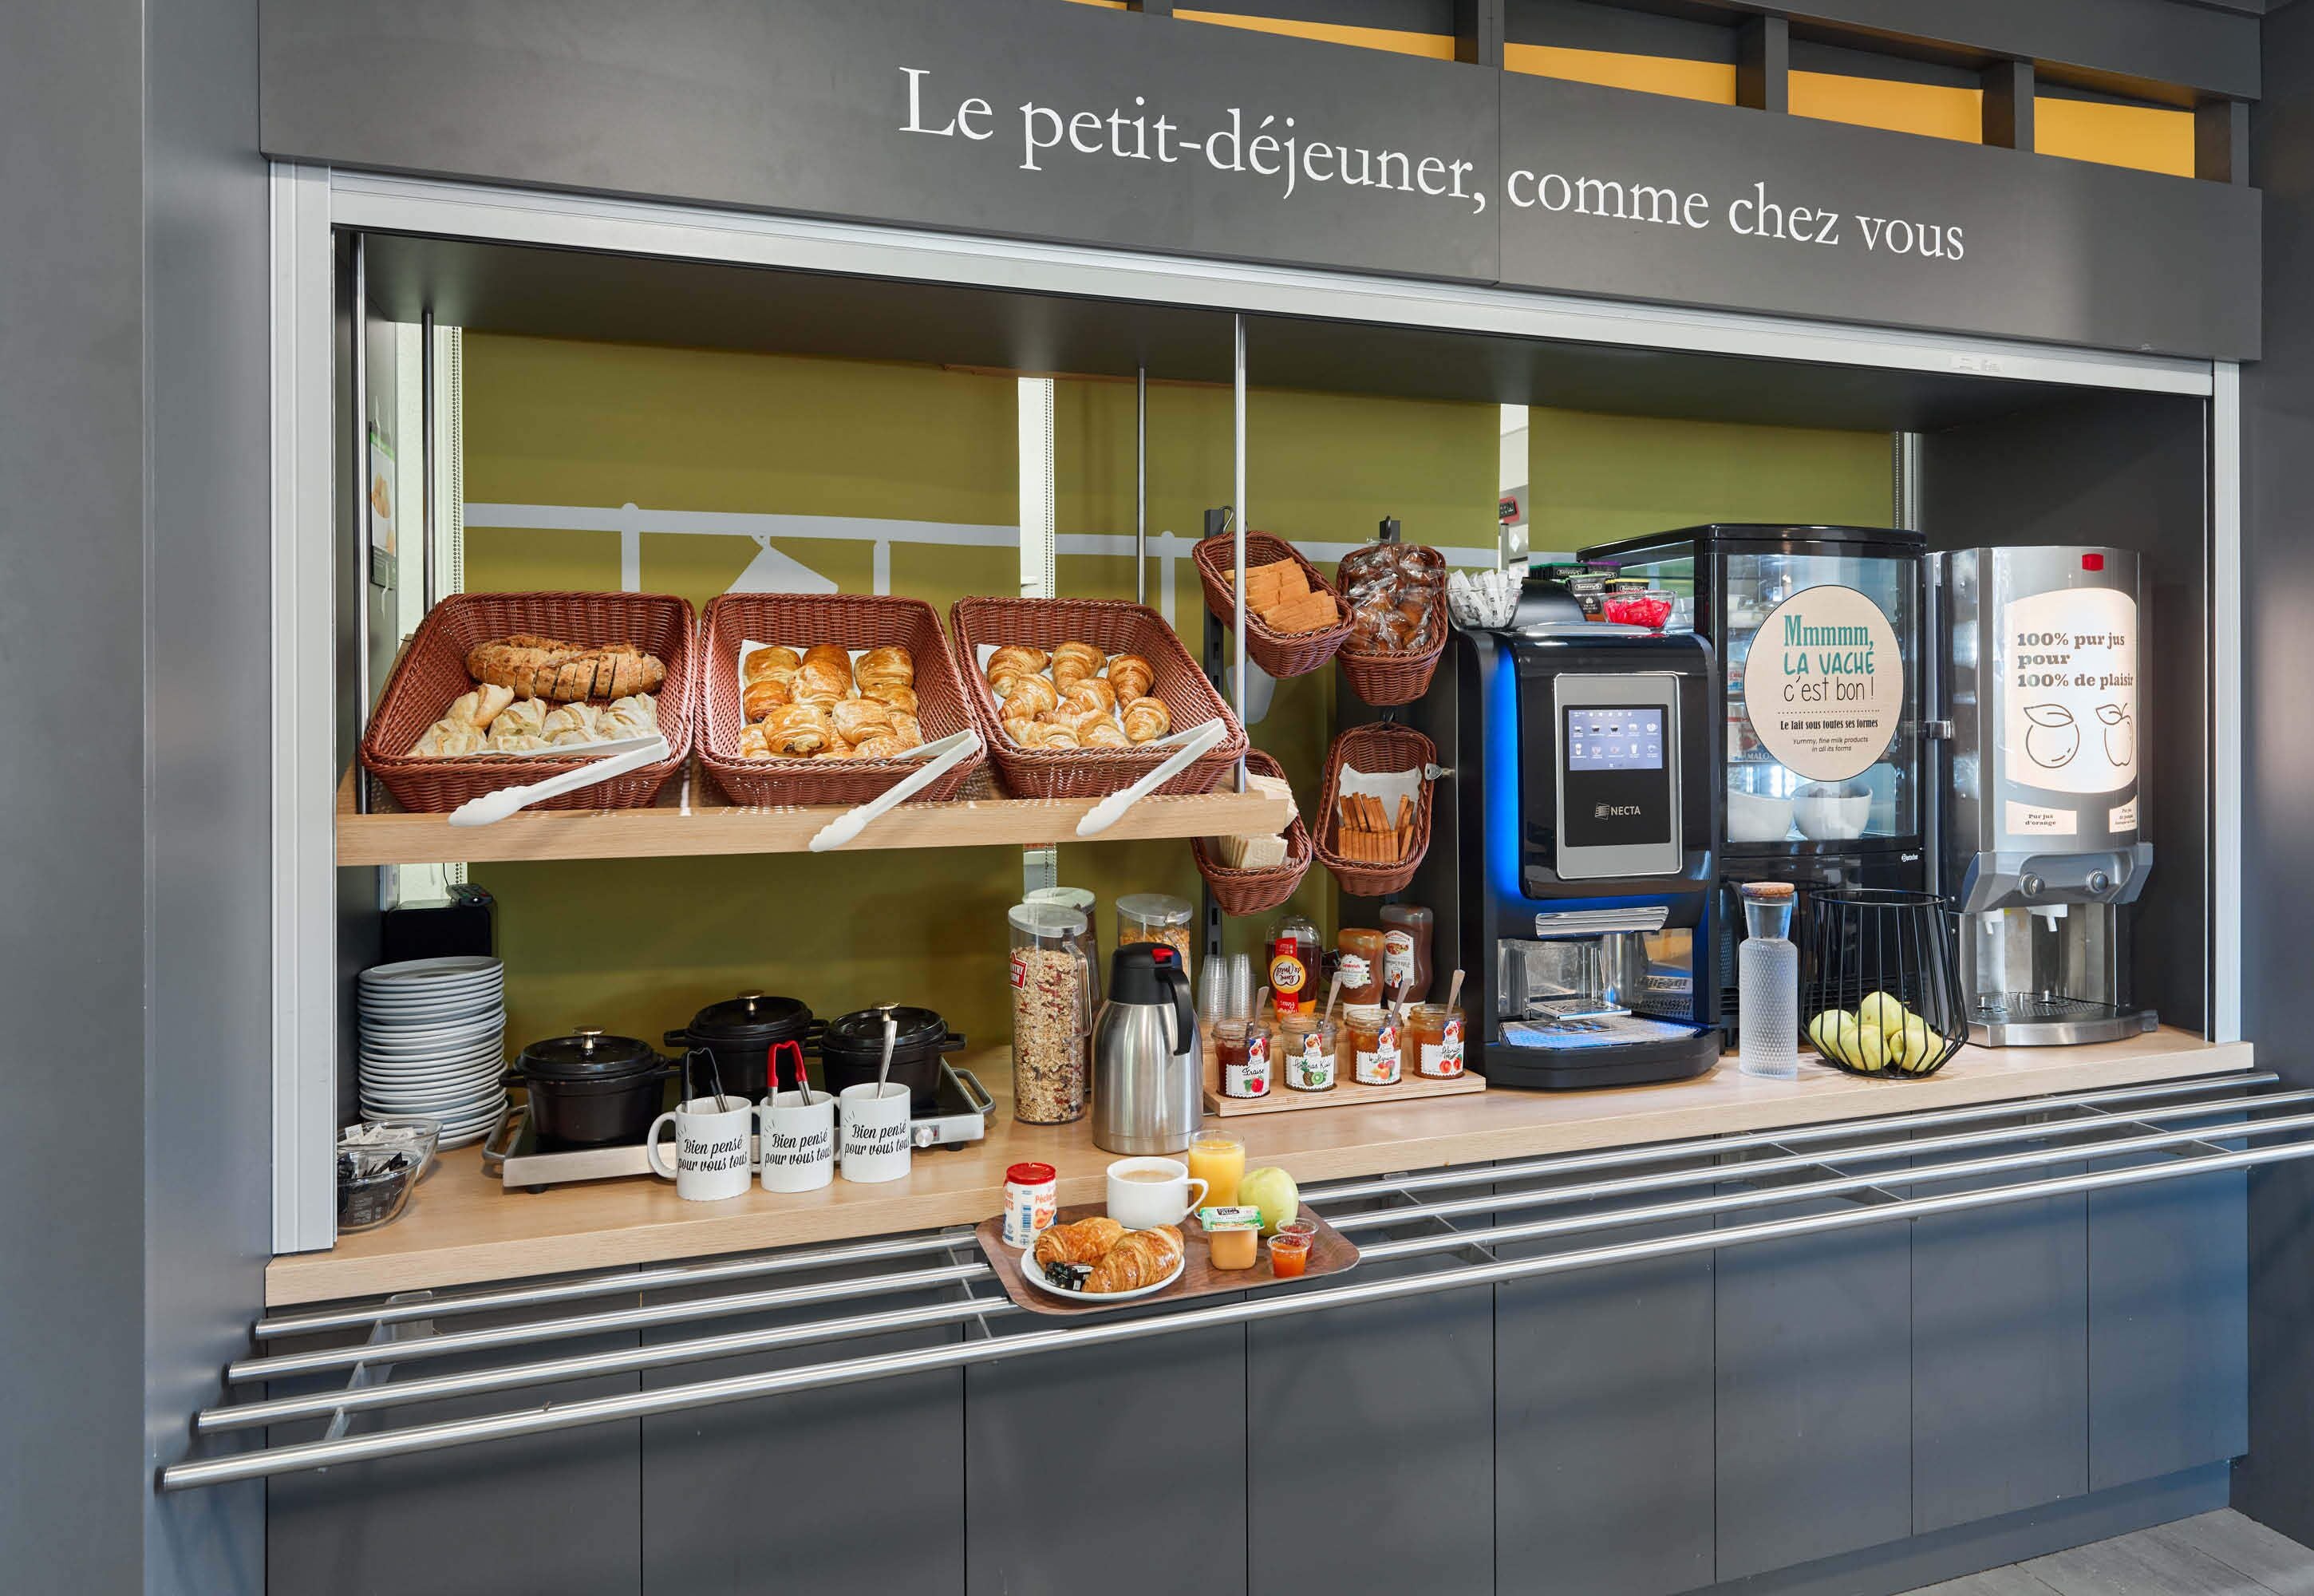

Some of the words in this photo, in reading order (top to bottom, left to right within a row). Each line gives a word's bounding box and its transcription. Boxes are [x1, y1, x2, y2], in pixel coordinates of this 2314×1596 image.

[898, 66, 994, 140] Le
[1019, 96, 1487, 215] petit-déjeuner,
[1507, 169, 1709, 229] comme
[1728, 182, 1839, 245] chez
[1855, 215, 1965, 260] vous
[1784, 614, 1874, 650] Mmmmm,
[2017, 632, 2069, 646] 100%
[2075, 635, 2105, 650] pur
[2107, 632, 2125, 650] jus
[1784, 652, 1809, 675] LA
[1819, 651, 1874, 675] VACHE
[2017, 654, 2071, 669] pour
[1783, 675, 1829, 701] c'est
[1836, 676, 1865, 701] bon
[1870, 676, 1874, 701] !
[2017, 673, 2069, 687] 100%
[2075, 673, 2096, 687] de
[2100, 673, 2133, 689] plaisir
[1780, 721, 1789, 730] Le
[1806, 721, 1821, 729] sous
[1822, 720, 1844, 729] toutes
[1846, 720, 1855, 729] ses
[1857, 718, 1878, 728] formes
[1844, 737, 1869, 745] products
[1610, 805, 1641, 816] NECTA
[1242, 1065, 1264, 1076] Fraise
[772, 1133, 797, 1148] Bien
[799, 1128, 828, 1153] pensé
[851, 1124, 877, 1139] Bien
[879, 1119, 906, 1144] pensé
[684, 1139, 709, 1154] Bien
[710, 1134, 743, 1159] pensé
[764, 1152, 787, 1167] pour
[788, 1150, 815, 1165] vous
[816, 1145, 831, 1163] tous
[844, 1142, 867, 1157] pour
[869, 1139, 894, 1156] vous
[678, 1158, 697, 1173] pour
[700, 1156, 726, 1171] vous
[729, 1152, 748, 1169] tous
